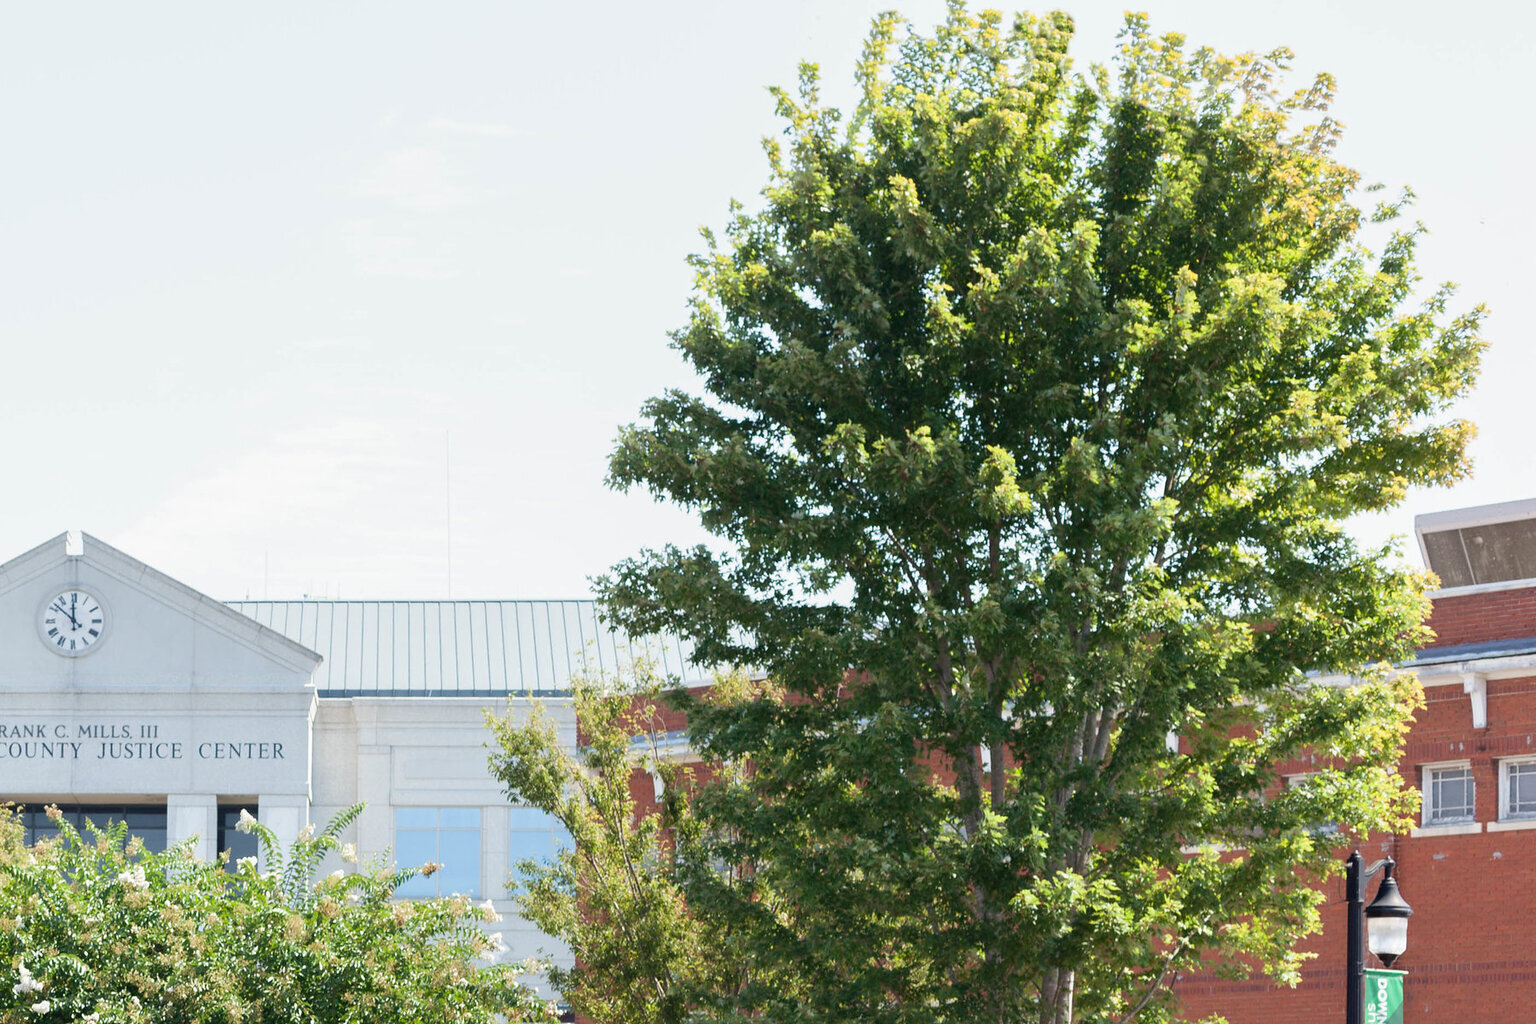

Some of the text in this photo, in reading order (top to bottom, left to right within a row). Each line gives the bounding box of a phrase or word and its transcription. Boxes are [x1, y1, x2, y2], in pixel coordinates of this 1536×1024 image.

[54, 724, 69, 738] C.
[140, 724, 158, 738] III
[97, 742, 183, 760] JUSTICE
[199, 742, 285, 760] CENTER
